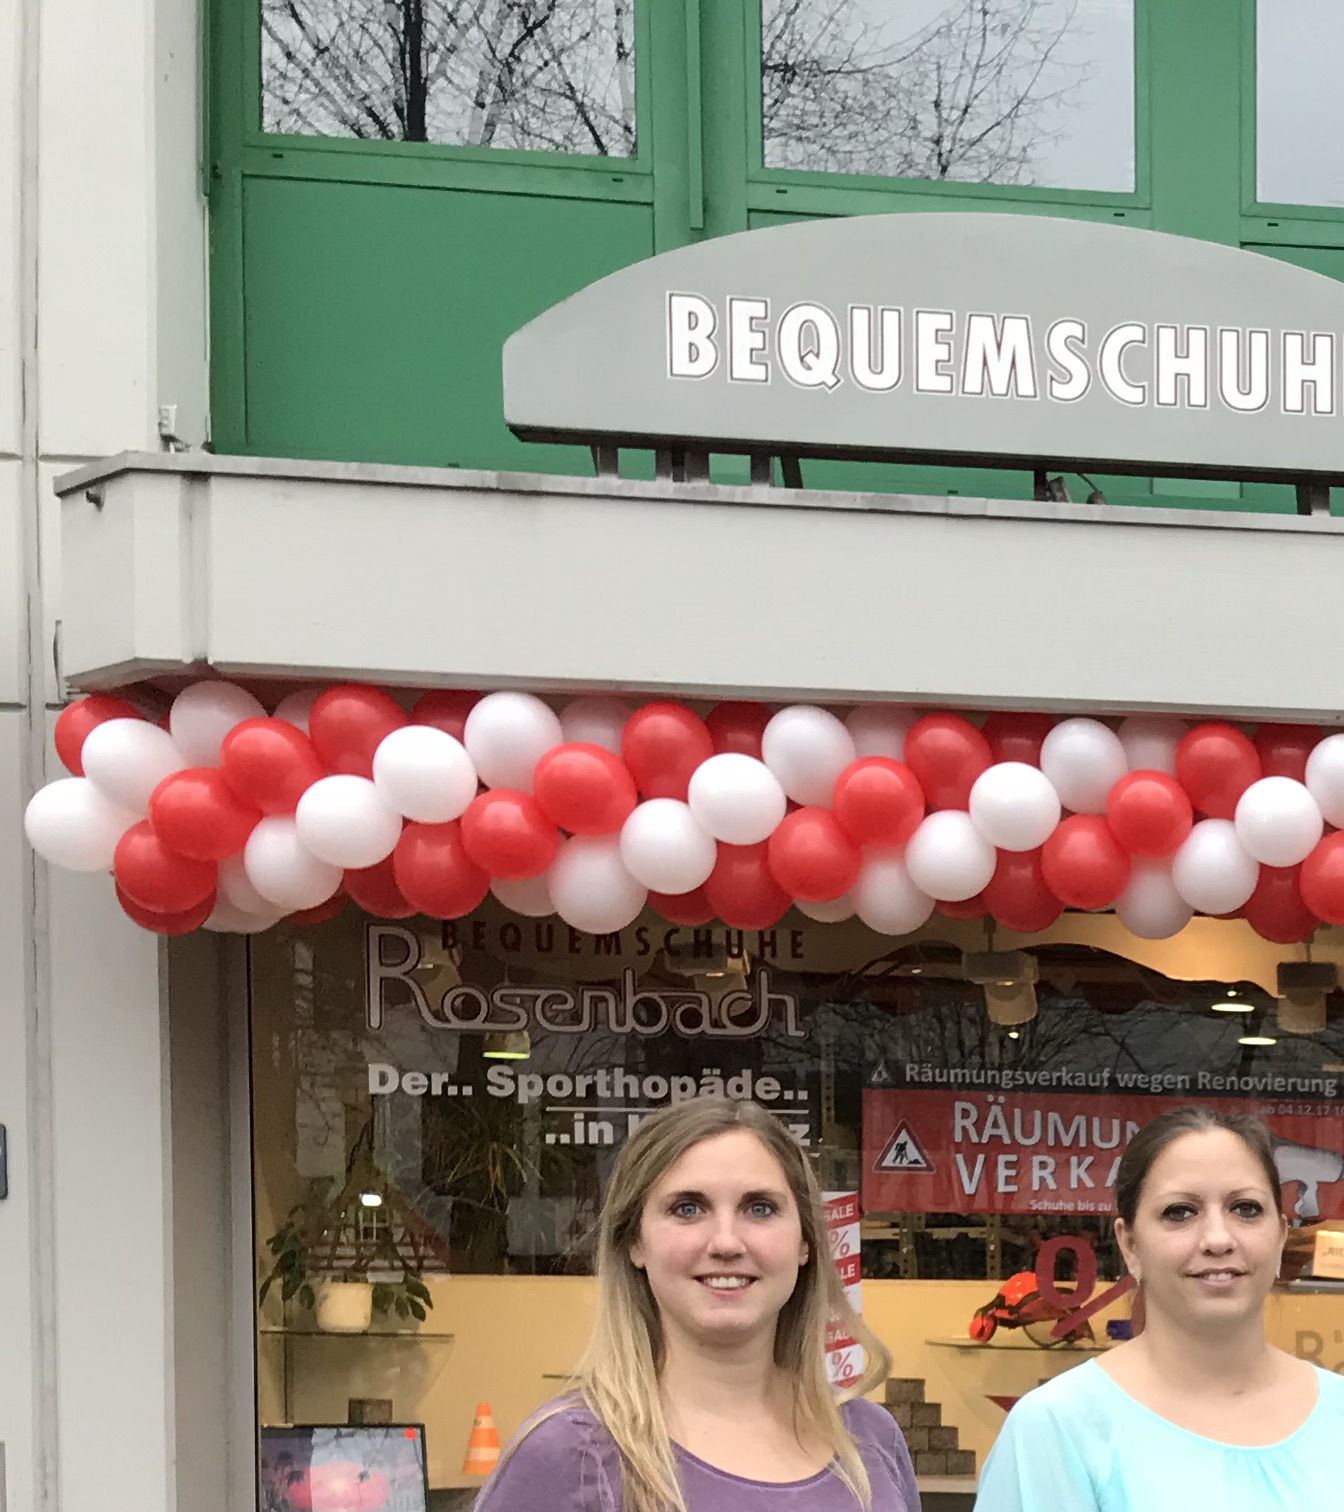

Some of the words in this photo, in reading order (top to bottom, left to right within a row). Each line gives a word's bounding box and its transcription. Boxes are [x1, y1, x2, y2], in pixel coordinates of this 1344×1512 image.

[440, 919, 806, 960] BEQUEMSCHUHE
[364, 922, 809, 1040] Rosenbach
[905, 1064, 1113, 1091] Räumungsverkauf
[1116, 1071, 1190, 1095] wegen
[1197, 1072, 1338, 1098] Renovierung
